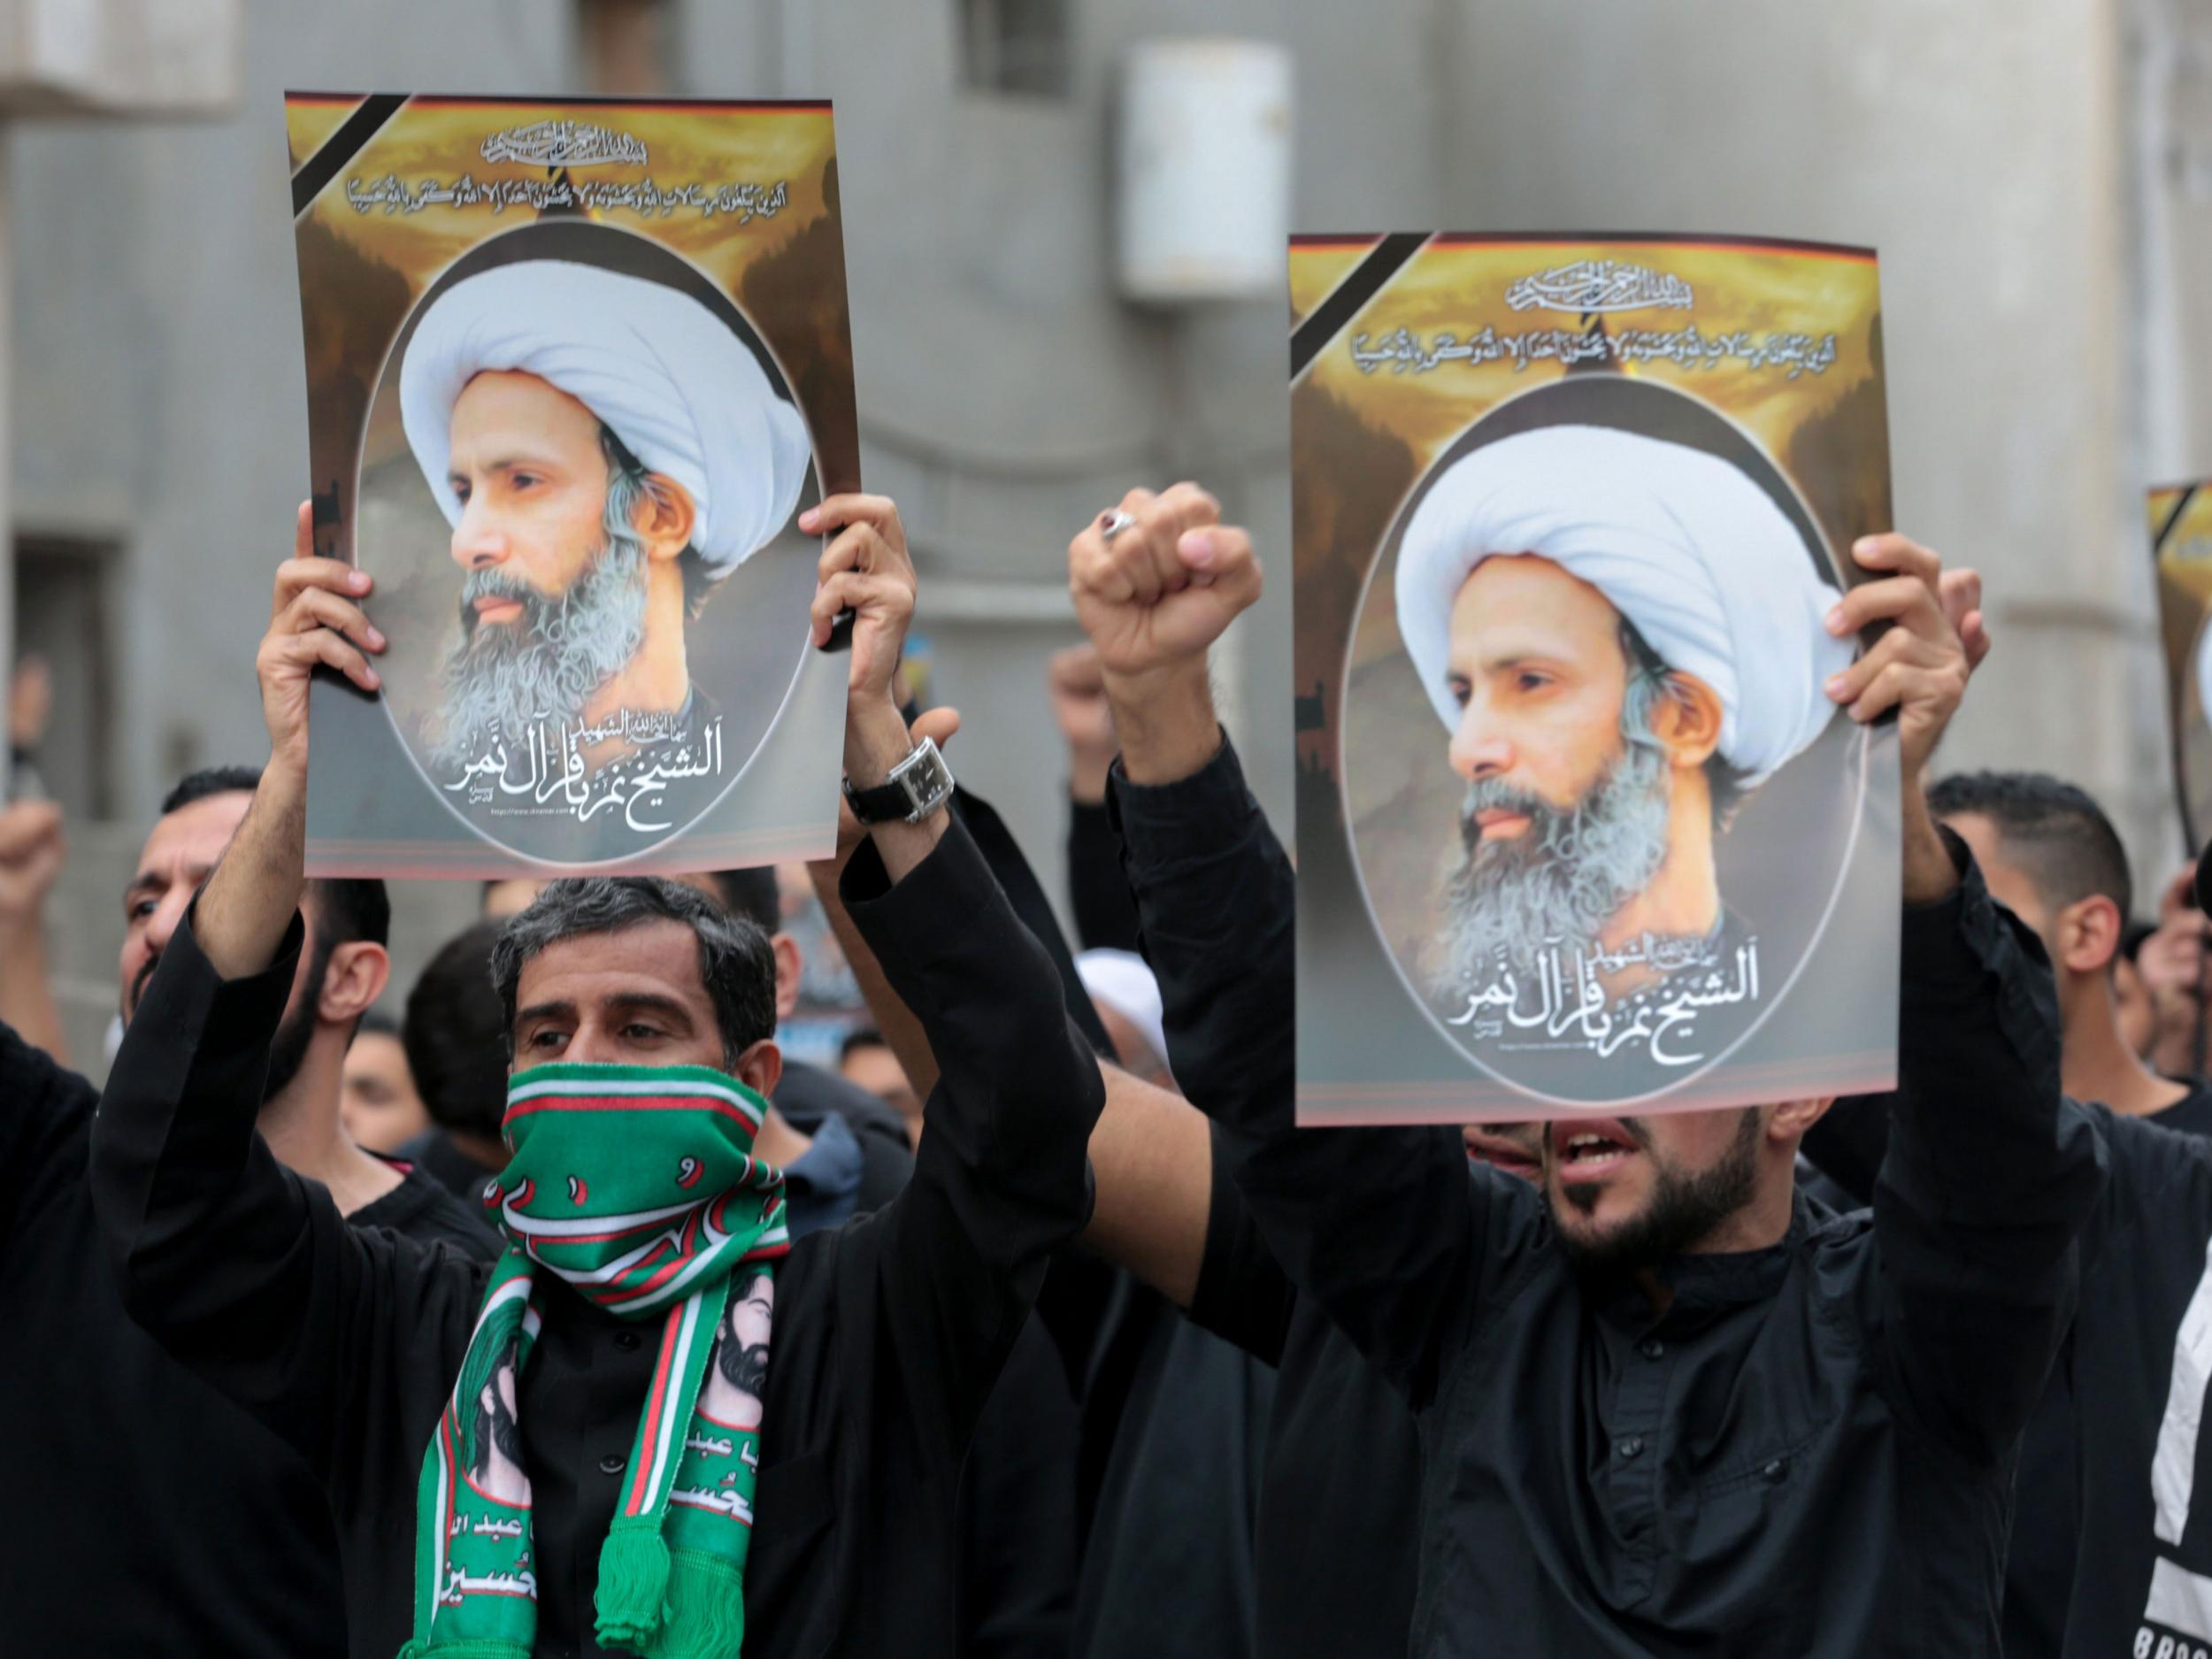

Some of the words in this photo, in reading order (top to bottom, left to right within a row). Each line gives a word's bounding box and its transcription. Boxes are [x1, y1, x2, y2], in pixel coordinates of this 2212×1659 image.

[500, 710, 550, 795] آل
[578, 763, 626, 823] نمر
[626, 717, 723, 832] الشيخ
[1507, 936, 1563, 1028] آل
[1598, 994, 1652, 1058] نمر
[1650, 937, 1758, 1065] الشيخ
